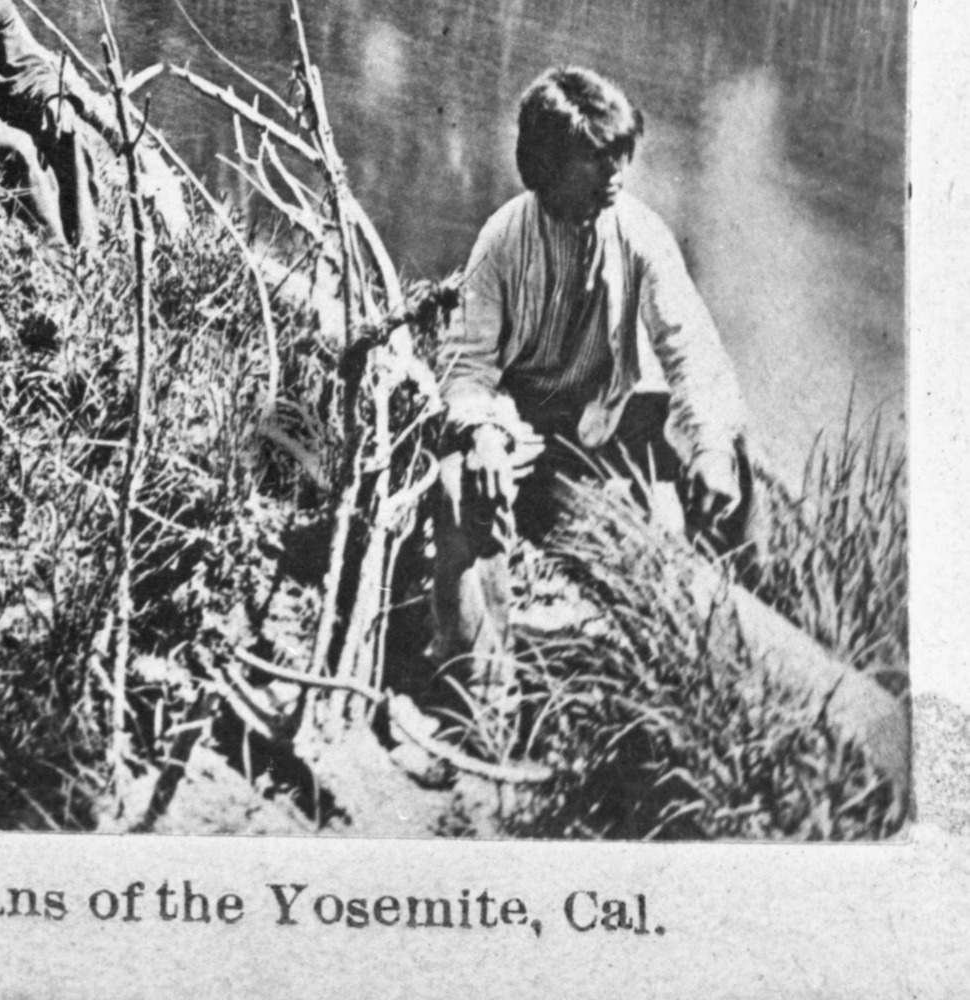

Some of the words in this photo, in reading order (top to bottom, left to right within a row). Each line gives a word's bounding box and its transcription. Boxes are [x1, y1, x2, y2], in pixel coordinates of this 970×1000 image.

[88, 880, 145, 921] of
[156, 882, 244, 923] the
[269, 883, 542, 936] Yosemite,
[563, 891, 665, 934] Cal.
